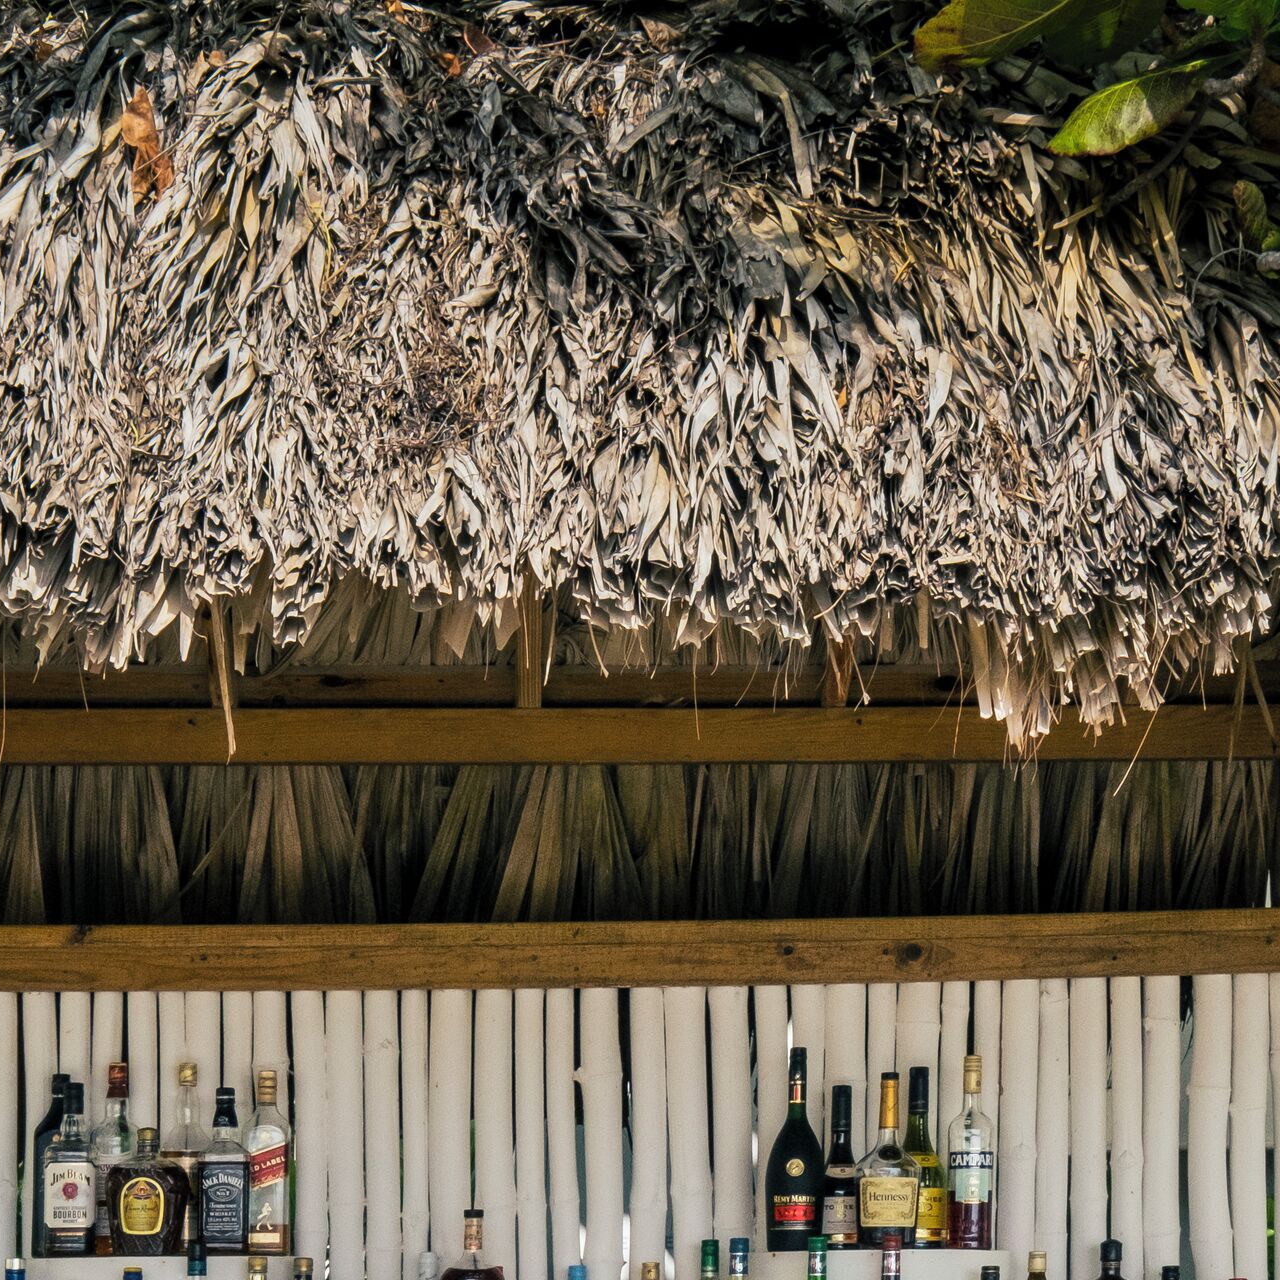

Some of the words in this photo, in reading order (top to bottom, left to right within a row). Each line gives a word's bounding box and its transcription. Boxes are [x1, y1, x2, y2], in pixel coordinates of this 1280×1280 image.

[261, 1156, 286, 1169] LABEL
[951, 1154, 993, 1167] CAMPARI
[51, 1173, 65, 1186] JIM
[67, 1169, 91, 1186] BEAM
[203, 1176, 218, 1189] JACK
[869, 1191, 910, 1202] Hennessy
[53, 1210, 87, 1220] BOURBON
